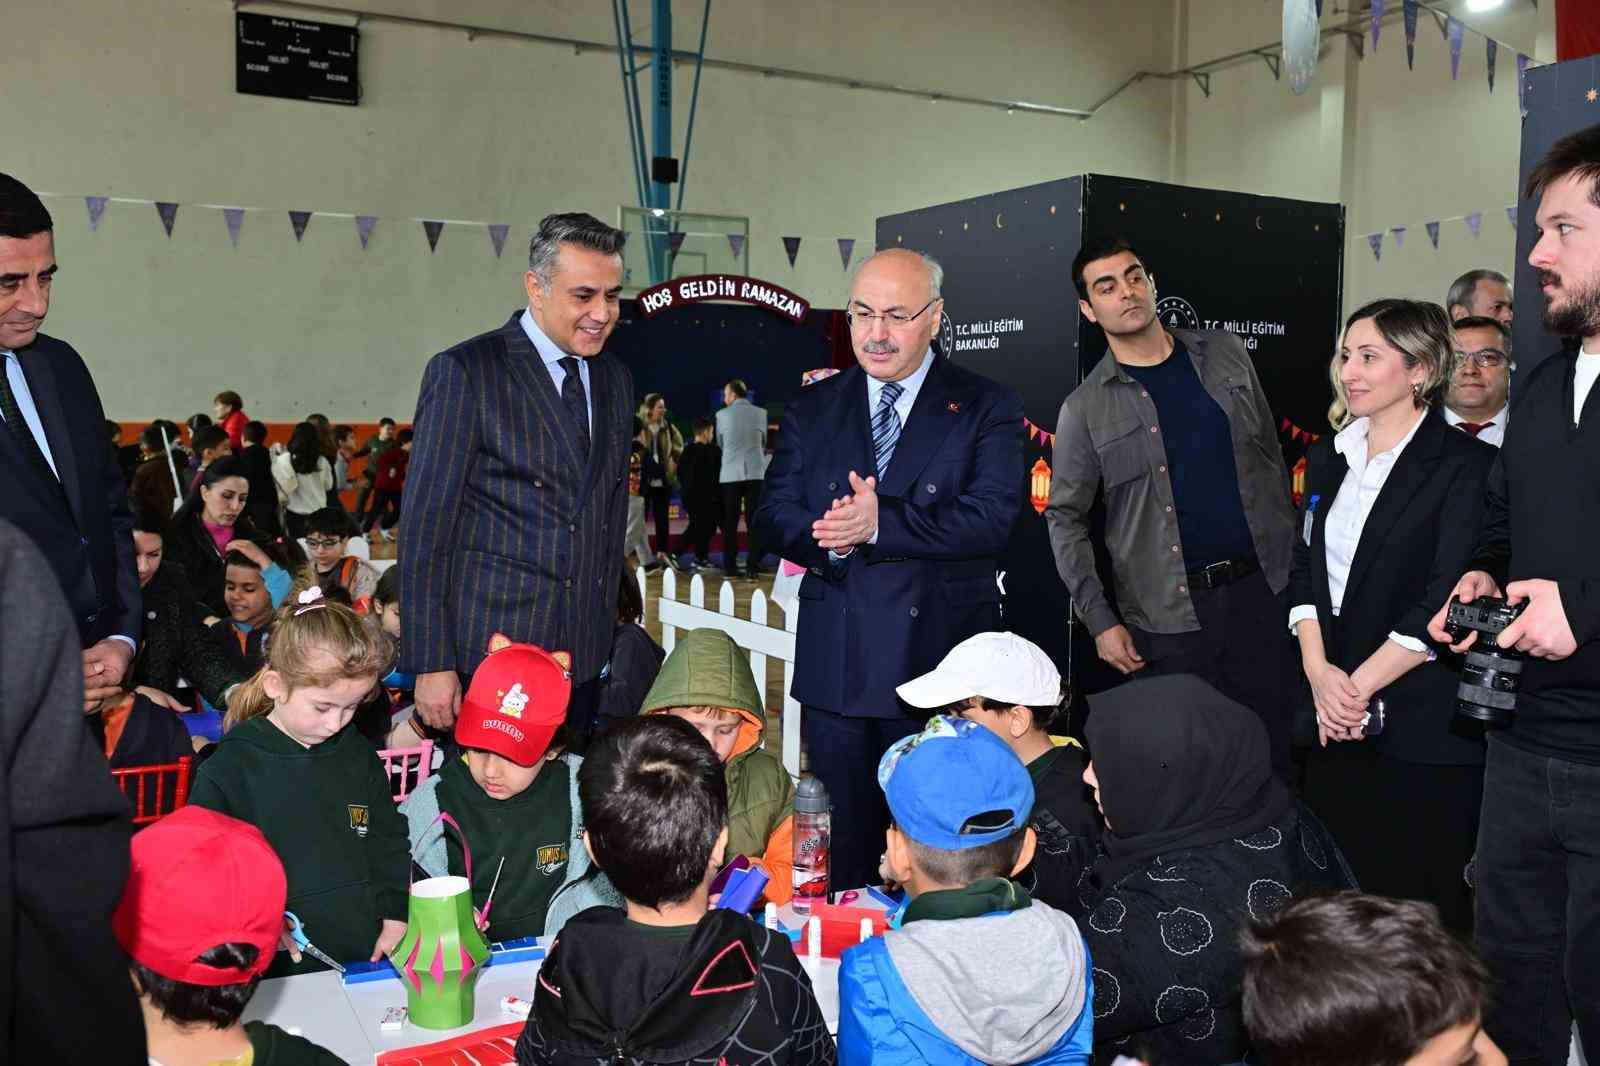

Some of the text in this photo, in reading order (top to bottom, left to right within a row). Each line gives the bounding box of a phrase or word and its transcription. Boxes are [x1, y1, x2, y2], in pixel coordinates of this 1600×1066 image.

[246, 63, 270, 73] SCORE
[326, 73, 349, 83] SCORE
[642, 276, 805, 318] HOŞ GELDİN RAMAZAN
[956, 324, 970, 336] T.C.
[993, 317, 1024, 334] EĞİTİM
[1251, 320, 1286, 336] EĞİTİM
[955, 335, 1000, 352] BAKANLIĞI
